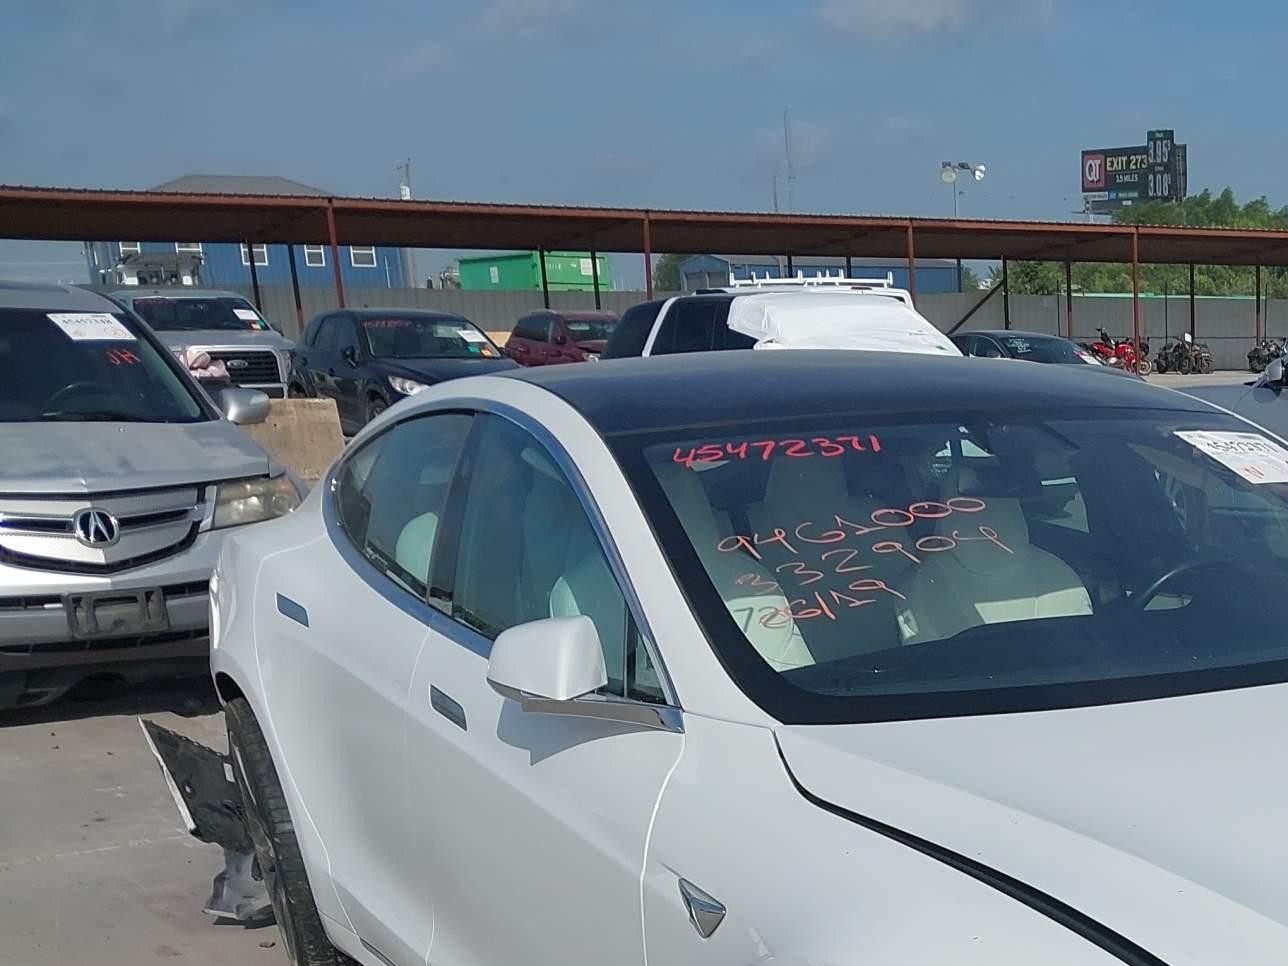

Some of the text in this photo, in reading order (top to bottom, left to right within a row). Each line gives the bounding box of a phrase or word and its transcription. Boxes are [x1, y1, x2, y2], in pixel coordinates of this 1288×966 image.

[1086, 159, 1101, 182] QT
[1106, 154, 1147, 171] EXIT 273
[673, 434, 883, 471] 45472371
